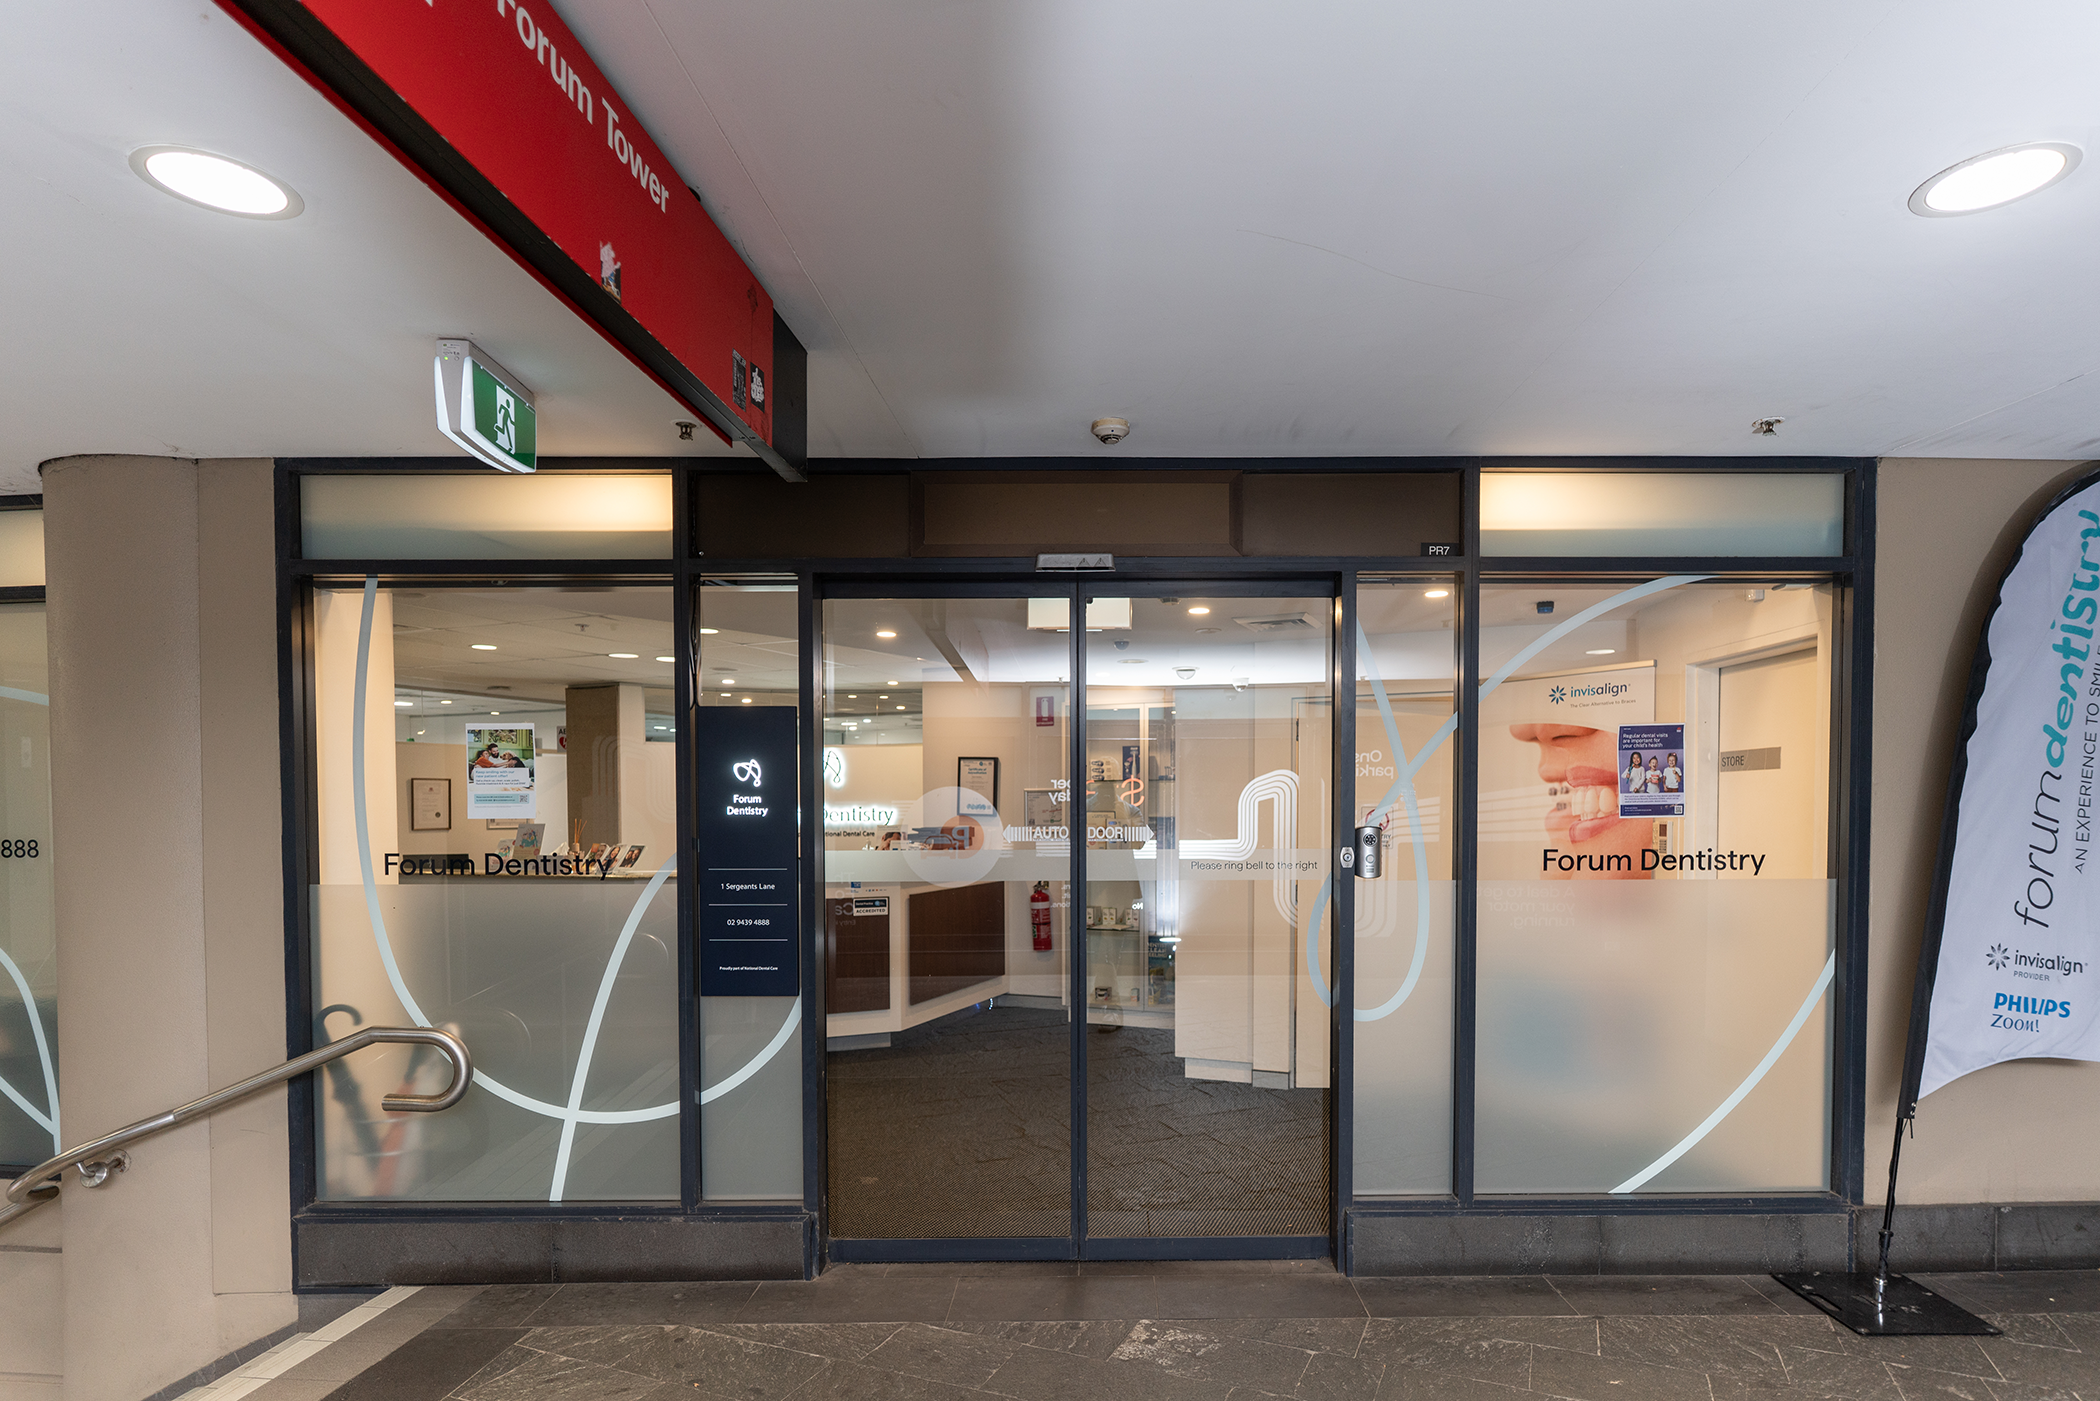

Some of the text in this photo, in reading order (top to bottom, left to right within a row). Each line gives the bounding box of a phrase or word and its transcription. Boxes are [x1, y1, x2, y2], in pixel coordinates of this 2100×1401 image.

[601, 97, 669, 214] Tower
[1428, 545, 1450, 556] PR7
[1570, 682, 1628, 698] invisalign
[2085, 702, 2100, 726] TO
[1721, 755, 1745, 768] STORE
[2075, 731, 2098, 843] EXPERIENCE
[733, 794, 762, 804] Forum
[726, 805, 769, 817] Dentistry
[1033, 826, 1123, 839] AUTO DOOR
[1, 839, 39, 858] 888
[384, 852, 612, 881] Forum Dentistry
[1190, 861, 1318, 872] Please ring bell to the right
[1542, 847, 1766, 876] Forum Dentistry
[2074, 847, 2088, 875] AN
[726, 883, 758, 891] Sergeants
[2014, 949, 2084, 976] invisalign
[2013, 970, 2050, 982] PROVIDER
[1993, 992, 2072, 1019] PHILIPS
